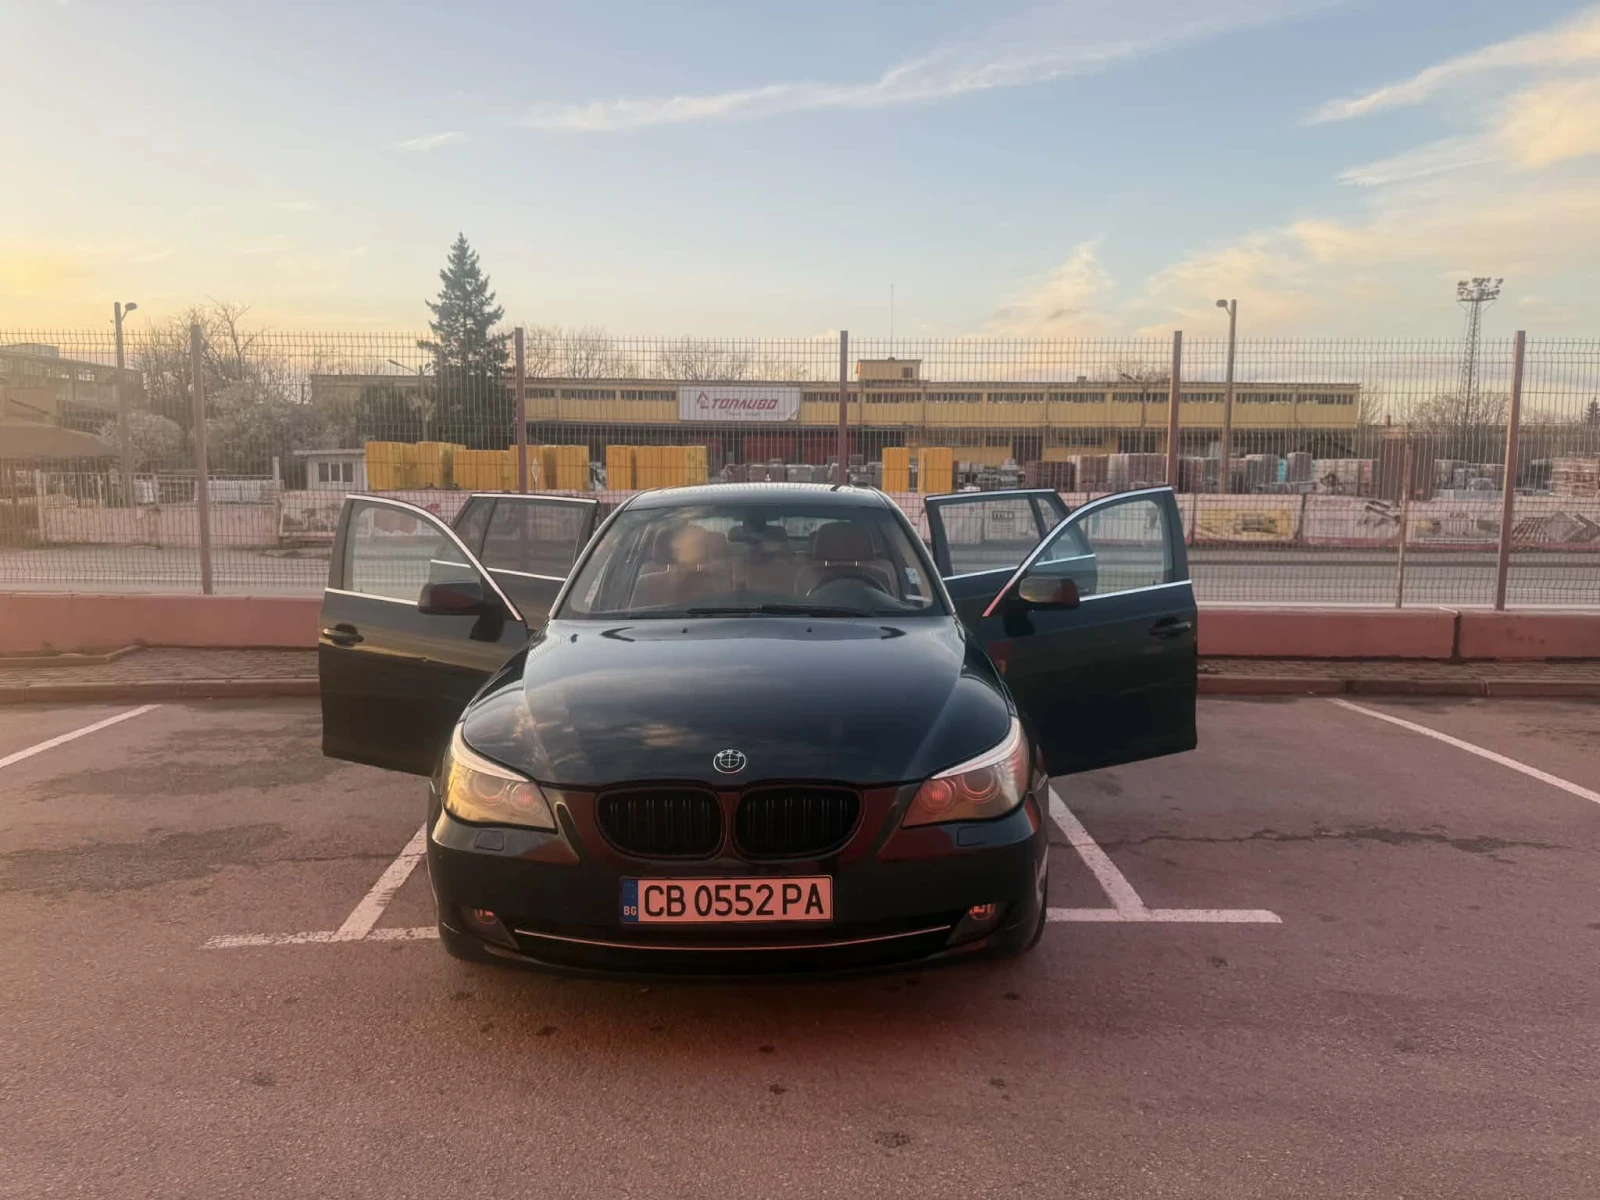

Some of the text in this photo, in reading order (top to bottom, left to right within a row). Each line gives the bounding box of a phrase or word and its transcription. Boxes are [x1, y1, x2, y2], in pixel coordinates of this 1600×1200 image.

[623, 905, 637, 916] BG
[644, 883, 824, 916] CB 0552 PA
